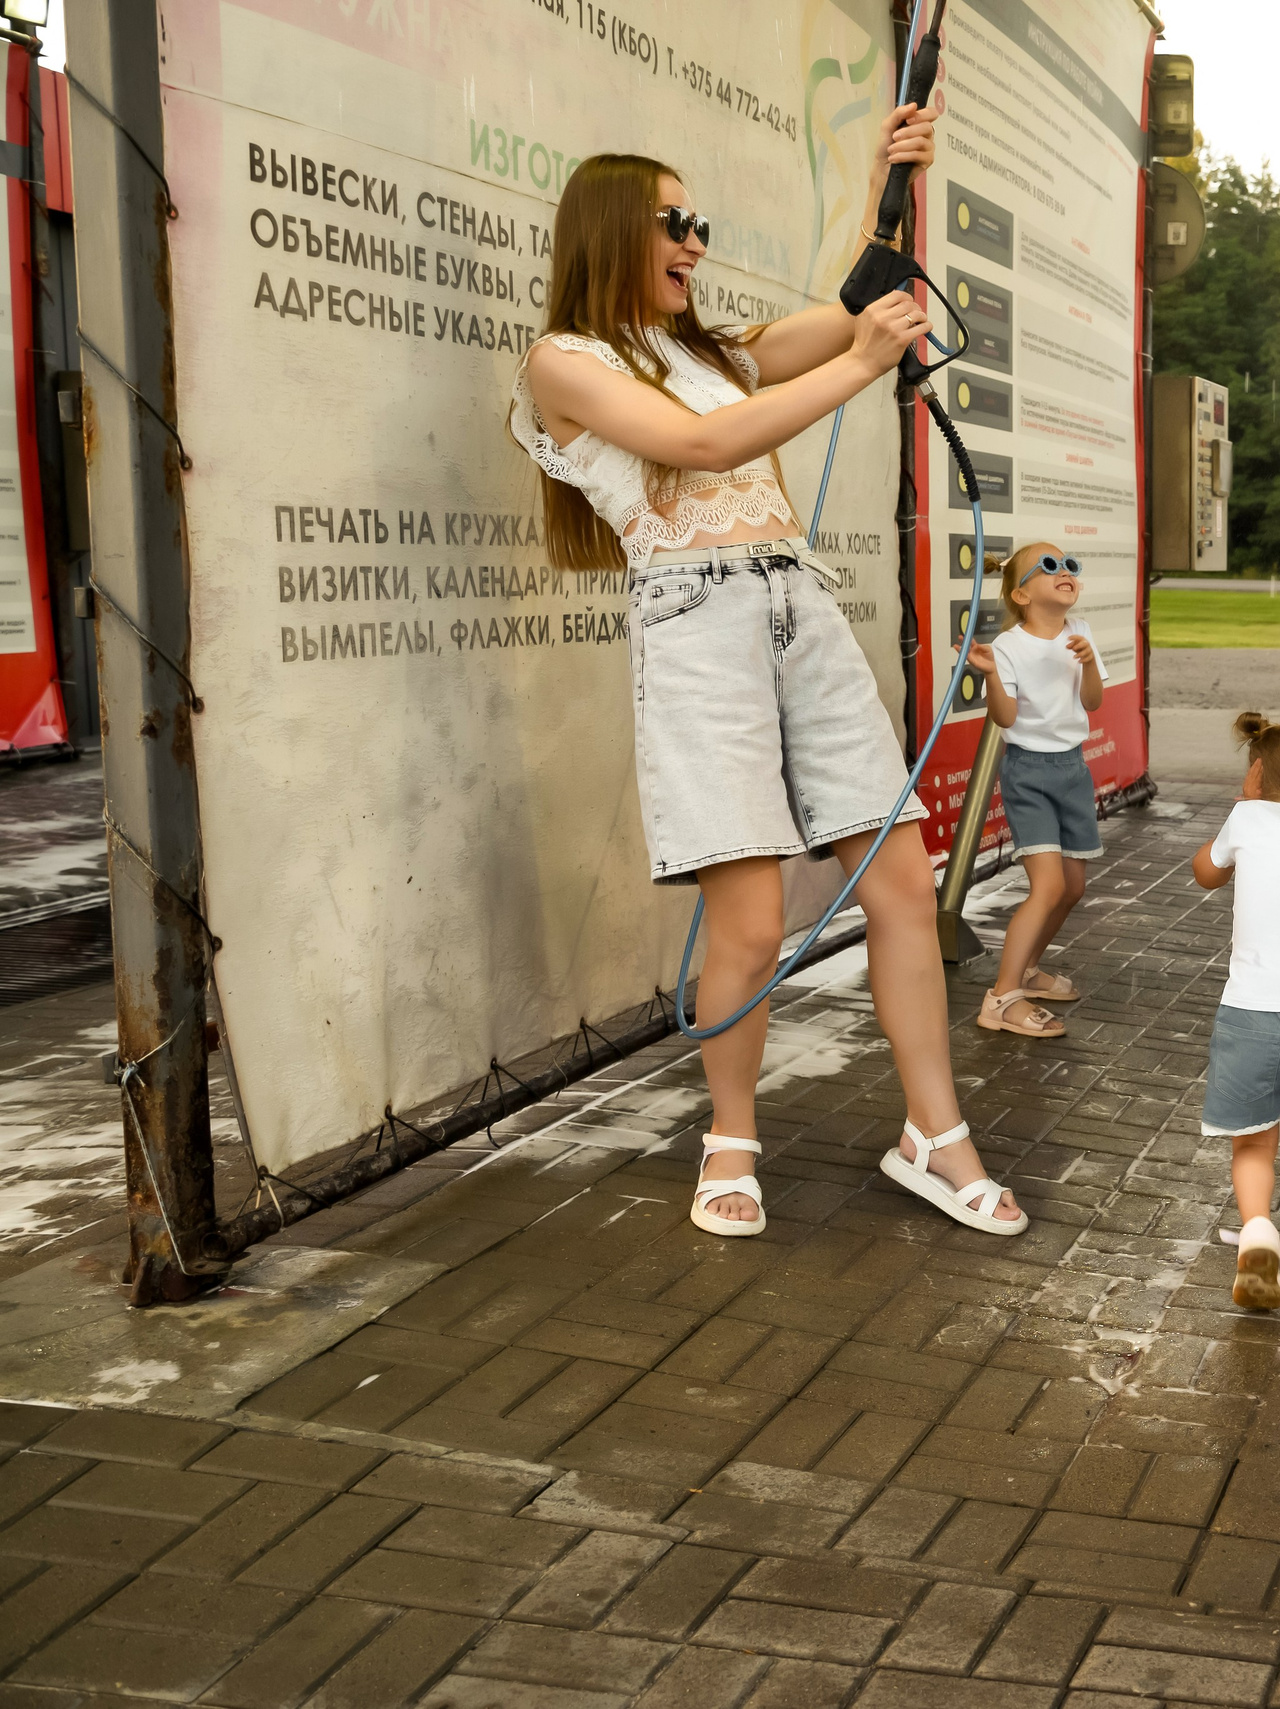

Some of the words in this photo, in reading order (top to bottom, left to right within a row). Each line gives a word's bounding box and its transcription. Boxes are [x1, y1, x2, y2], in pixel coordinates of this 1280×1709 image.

[576, 0, 606, 40] 115
[611, 15, 659, 75] (КБО)
[667, 46, 678, 79] Т.
[682, 61, 712, 98] +375
[716, 77, 732, 109] 44
[736, 87, 797, 143] 772-42-43
[947, 132, 978, 163] ТЕЛЕФОН
[979, 152, 1032, 196] АДМИНИСТРАТОРА:
[249, 142, 407, 225] ВЫВЕСКИ,
[416, 191, 523, 257] СТЕНДЫ,
[529, 223, 552, 262] ТА
[250, 207, 427, 282] ОБЪЕМНЫЕ
[436, 251, 522, 308] БУКВЫ,
[690, 276, 713, 312] РЫ,
[254, 271, 426, 338] АДРЕСНЫЕ
[433, 305, 540, 356] УКАЗАТЕ
[275, 505, 389, 544] ПЕЧАТЬ
[399, 510, 436, 545] НА
[813, 531, 844, 557] ЛКАХ,
[846, 532, 881, 555] ХОЛСТЕ
[278, 565, 417, 604] ВИЗИТКИ,
[426, 565, 570, 600] КАЛЕНДАРИ,
[280, 620, 442, 663] ВЫМПЕЛЫ,
[450, 614, 556, 650] ФЛАЖКИ,
[562, 605, 629, 646] БЕЙДЖ
